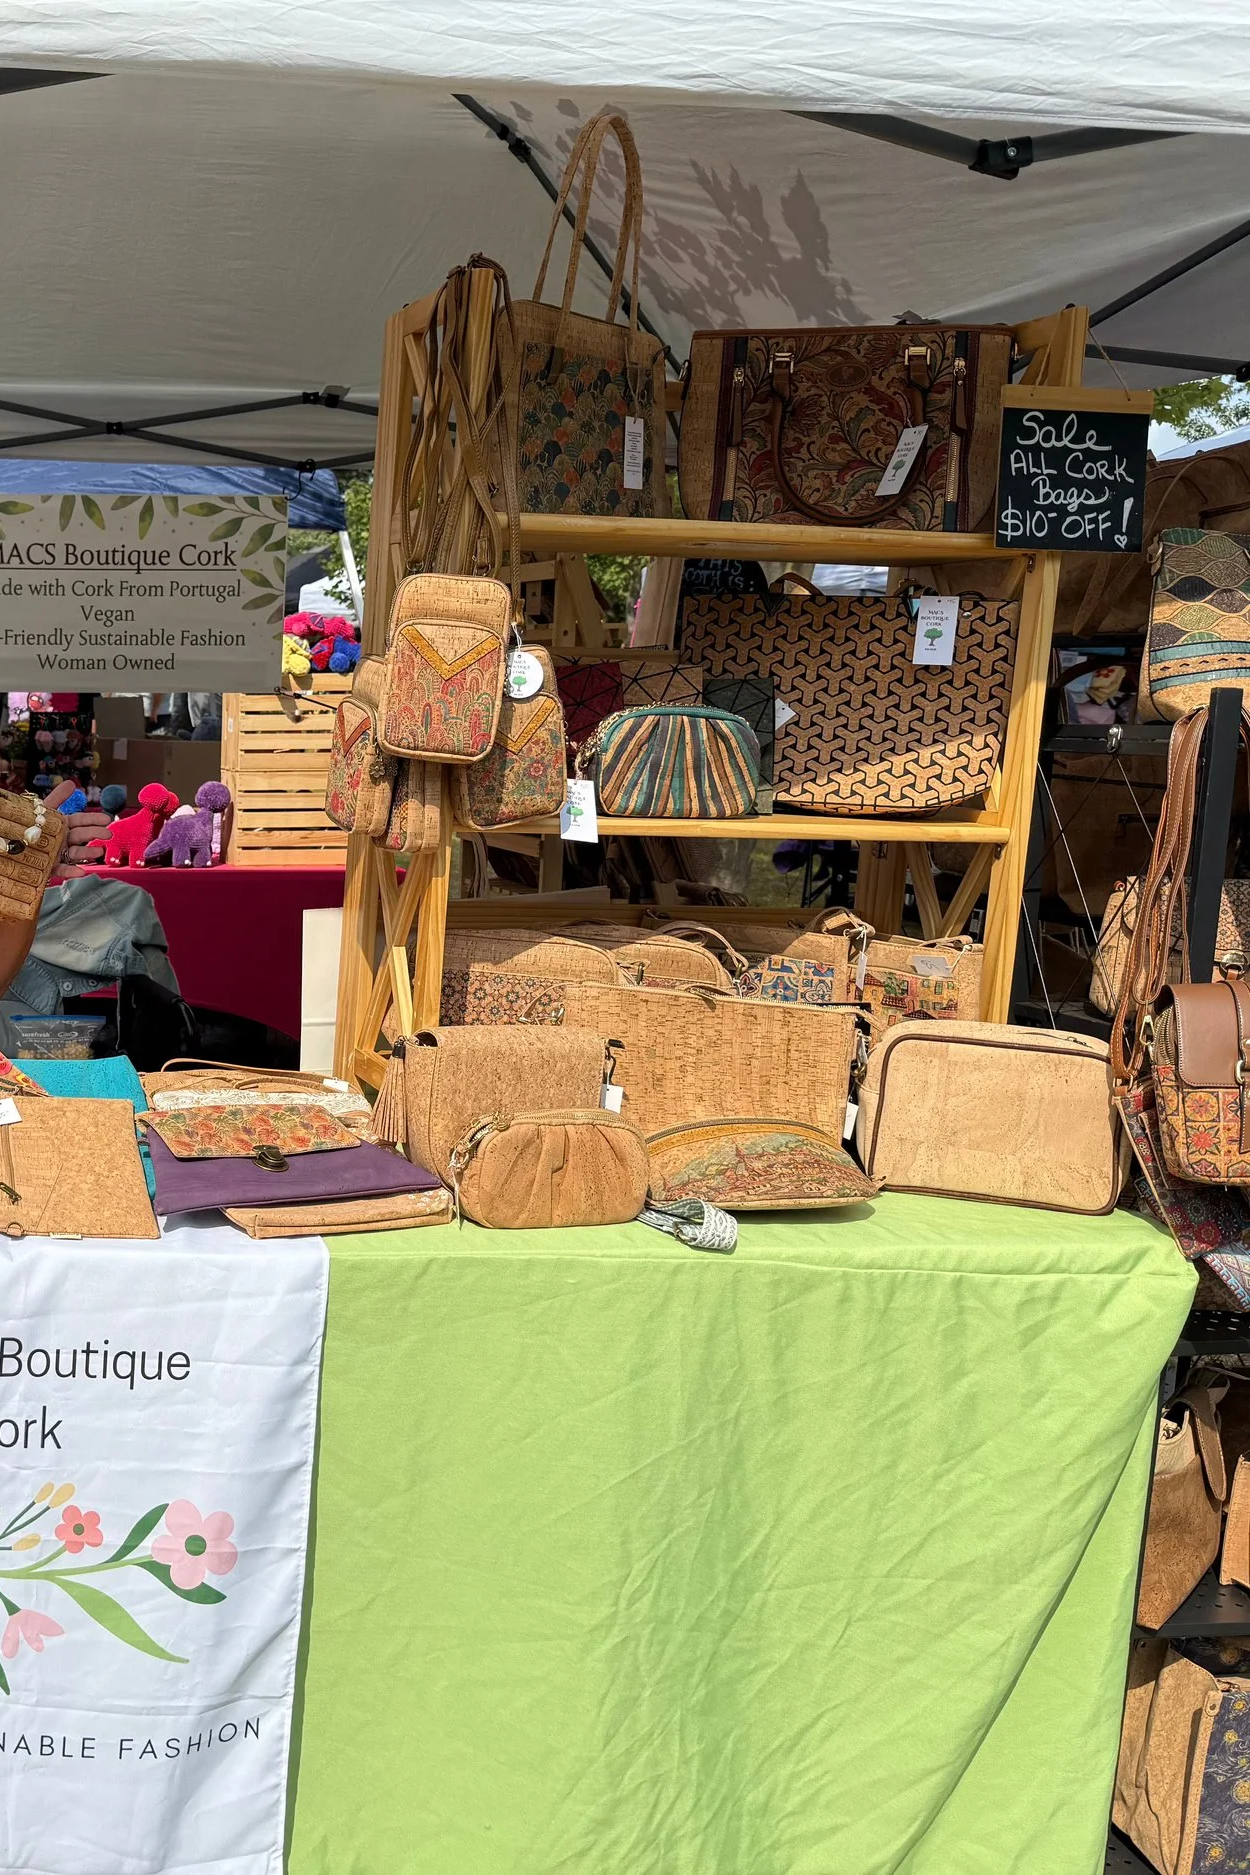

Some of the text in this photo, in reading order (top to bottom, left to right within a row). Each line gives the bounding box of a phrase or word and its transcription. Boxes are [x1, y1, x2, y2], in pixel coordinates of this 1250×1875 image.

[1016, 411, 1112, 451] Sale
[1010, 449, 1057, 476] ALL
[1031, 475, 1109, 512] Bags
[64, 542, 170, 575] Boutique
[178, 541, 237, 567] Cork
[684, 567, 721, 587] OOTH
[28, 578, 66, 597] with
[71, 578, 114, 597] Cork
[119, 580, 164, 597] From
[170, 579, 241, 604] Portugal
[80, 605, 135, 628] Vegan
[78, 628, 175, 646] Sustainable
[180, 628, 246, 646] Fashion
[37, 653, 175, 670] Woman Owned
[118, 1717, 260, 1760] FASHION
